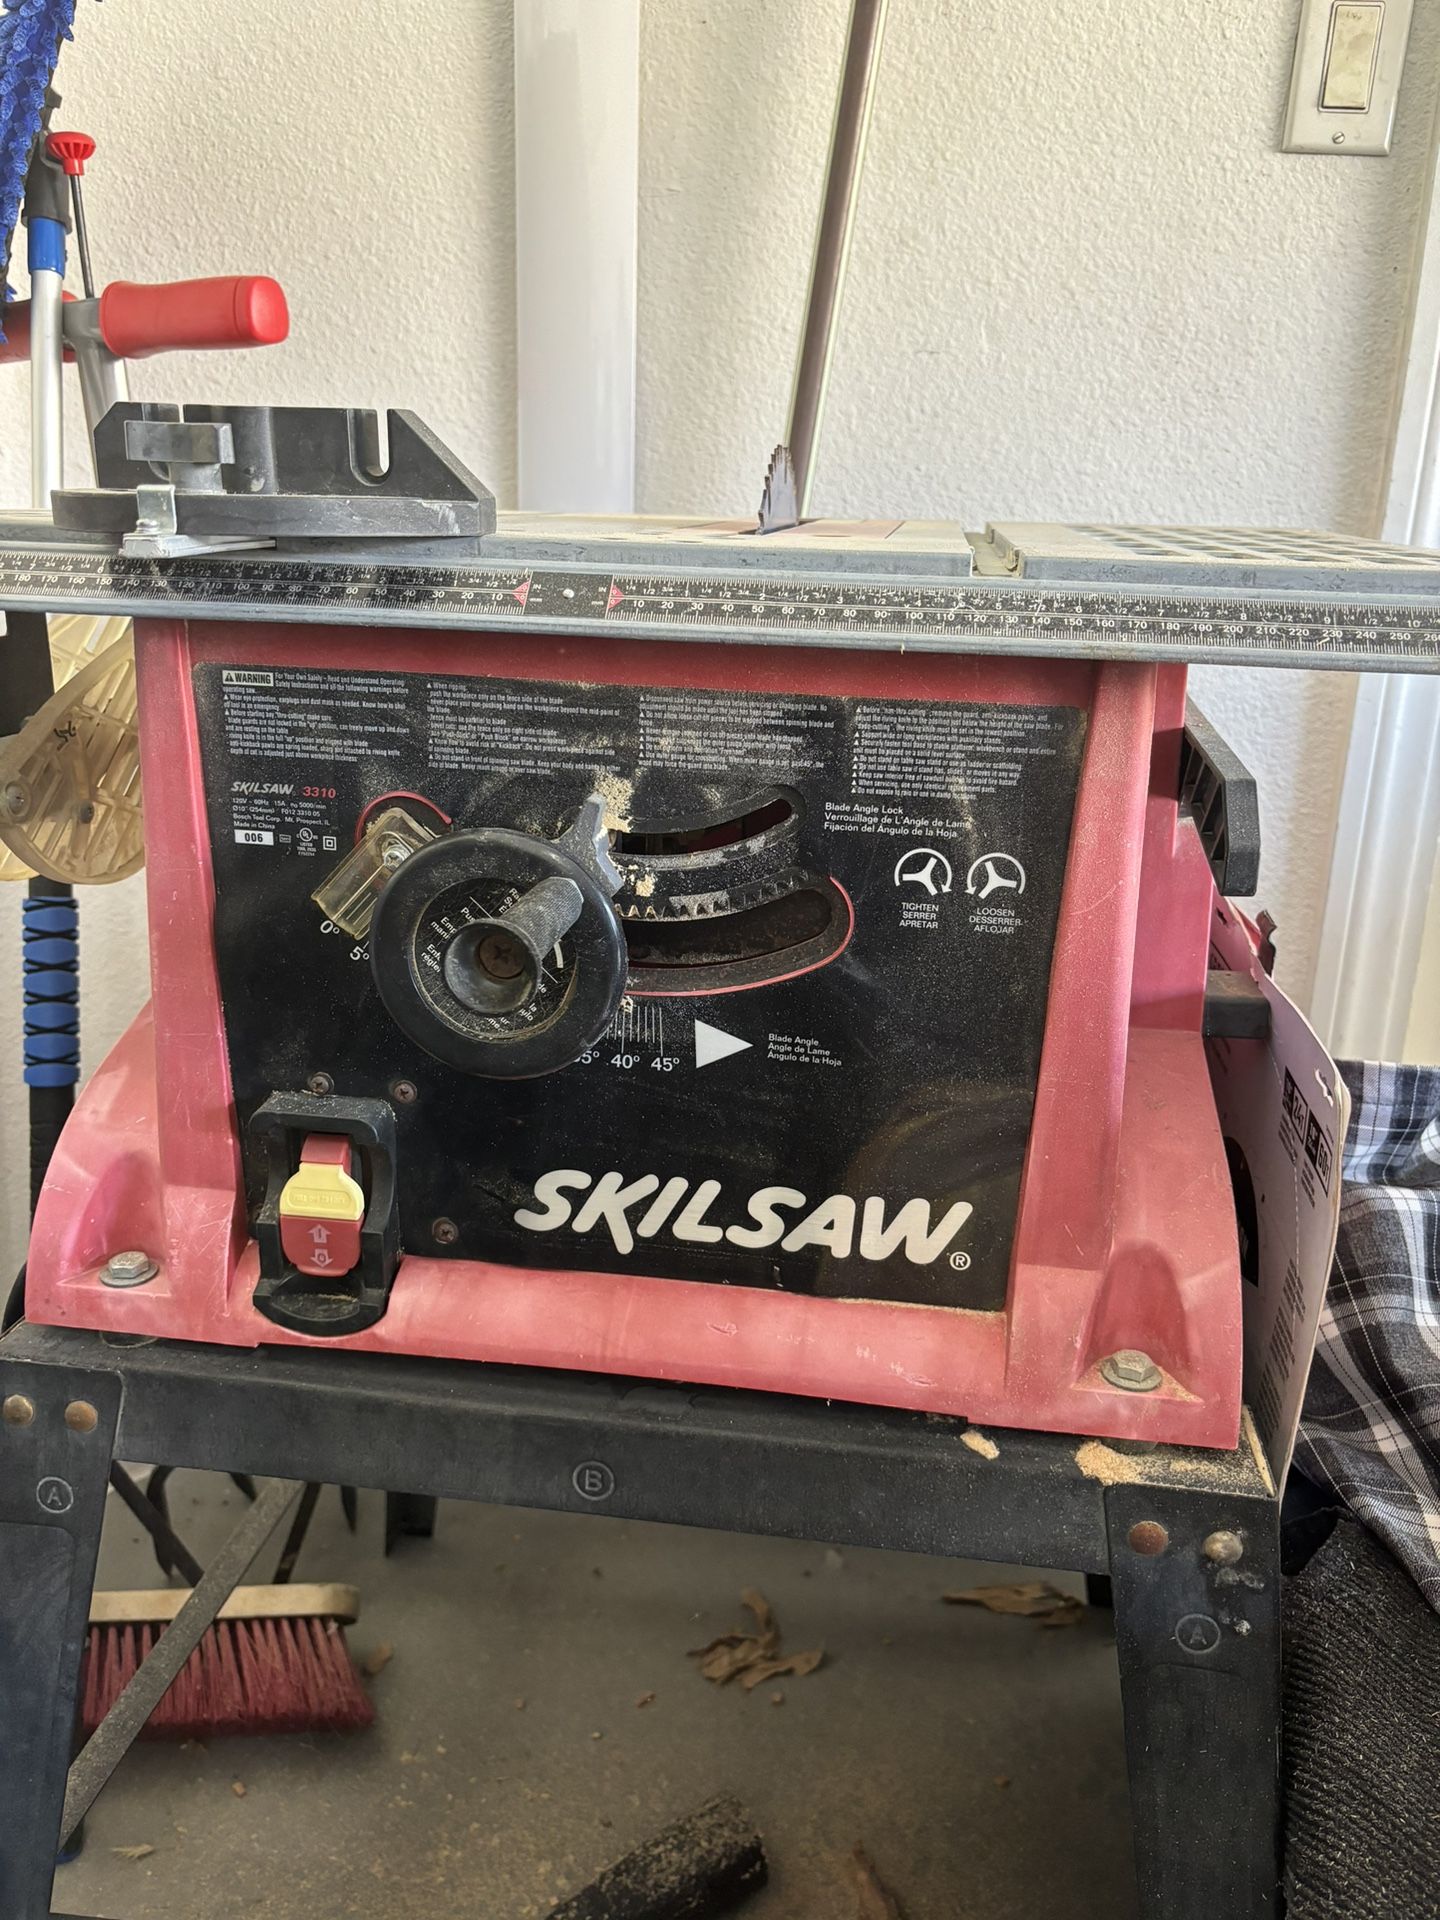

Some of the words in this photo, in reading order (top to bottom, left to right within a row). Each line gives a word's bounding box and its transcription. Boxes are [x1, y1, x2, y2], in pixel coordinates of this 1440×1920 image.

[14, 574, 31, 582] 180
[150, 580, 168, 588] 130
[432, 590, 446, 598] 30
[492, 592, 504, 600] 10
[813, 608, 826, 616] 70
[842, 610, 856, 618] 80
[874, 610, 888, 618] 90
[968, 614, 987, 622] 120
[1000, 616, 1019, 624] 130
[1064, 618, 1082, 626] 150
[1096, 620, 1115, 628] 160
[1128, 621, 1148, 629] 170
[1160, 622, 1180, 630] 180
[1193, 624, 1213, 632] 190
[1223, 625, 1244, 634] 200
[1256, 626, 1276, 635] 210
[1289, 628, 1310, 636] 220
[1322, 630, 1343, 638] 230
[1356, 631, 1377, 640] 240
[1390, 632, 1411, 640] 250
[234, 672, 272, 684] WARNING
[275, 672, 284, 680] For
[380, 678, 405, 687] Operating
[368, 686, 392, 694] warnings
[230, 781, 294, 796] SKILSAW
[302, 786, 337, 799] 3310
[826, 802, 850, 812] Blade
[852, 804, 880, 814] Angle
[882, 805, 904, 815] Lock
[824, 812, 878, 824] Verrouillage
[880, 815, 892, 824] de
[894, 816, 930, 827] L'Angle
[931, 818, 944, 827] de
[824, 821, 859, 833] Fijación
[860, 824, 876, 833] del
[911, 827, 923, 836] de
[924, 828, 934, 836] la
[936, 828, 958, 839] Hoja
[244, 832, 264, 843] 006
[900, 902, 940, 912] TIGHTEN
[976, 907, 1015, 918] LOOSEN
[902, 910, 937, 921] SERRER
[969, 914, 1021, 926] DESSERRER
[320, 920, 340, 934] 0°
[898, 920, 938, 930] APRETAR
[974, 924, 1014, 934] AFLOJAR
[350, 946, 370, 960] 5°
[768, 1032, 793, 1044] Blade
[794, 1036, 819, 1047] Angle
[767, 1042, 792, 1053] Angle
[794, 1045, 805, 1054] de
[807, 1046, 830, 1056] Lame
[575, 1050, 600, 1064] 5°
[610, 1054, 640, 1070] 40°
[650, 1056, 680, 1072] 45°
[799, 1054, 810, 1063] de
[812, 1056, 820, 1064] la
[822, 1056, 842, 1068] Hoja
[513, 1169, 973, 1264] SKILSAW
[584, 1470, 602, 1490] B
[46, 1486, 63, 1506] A
[1190, 1623, 1208, 1646] A
